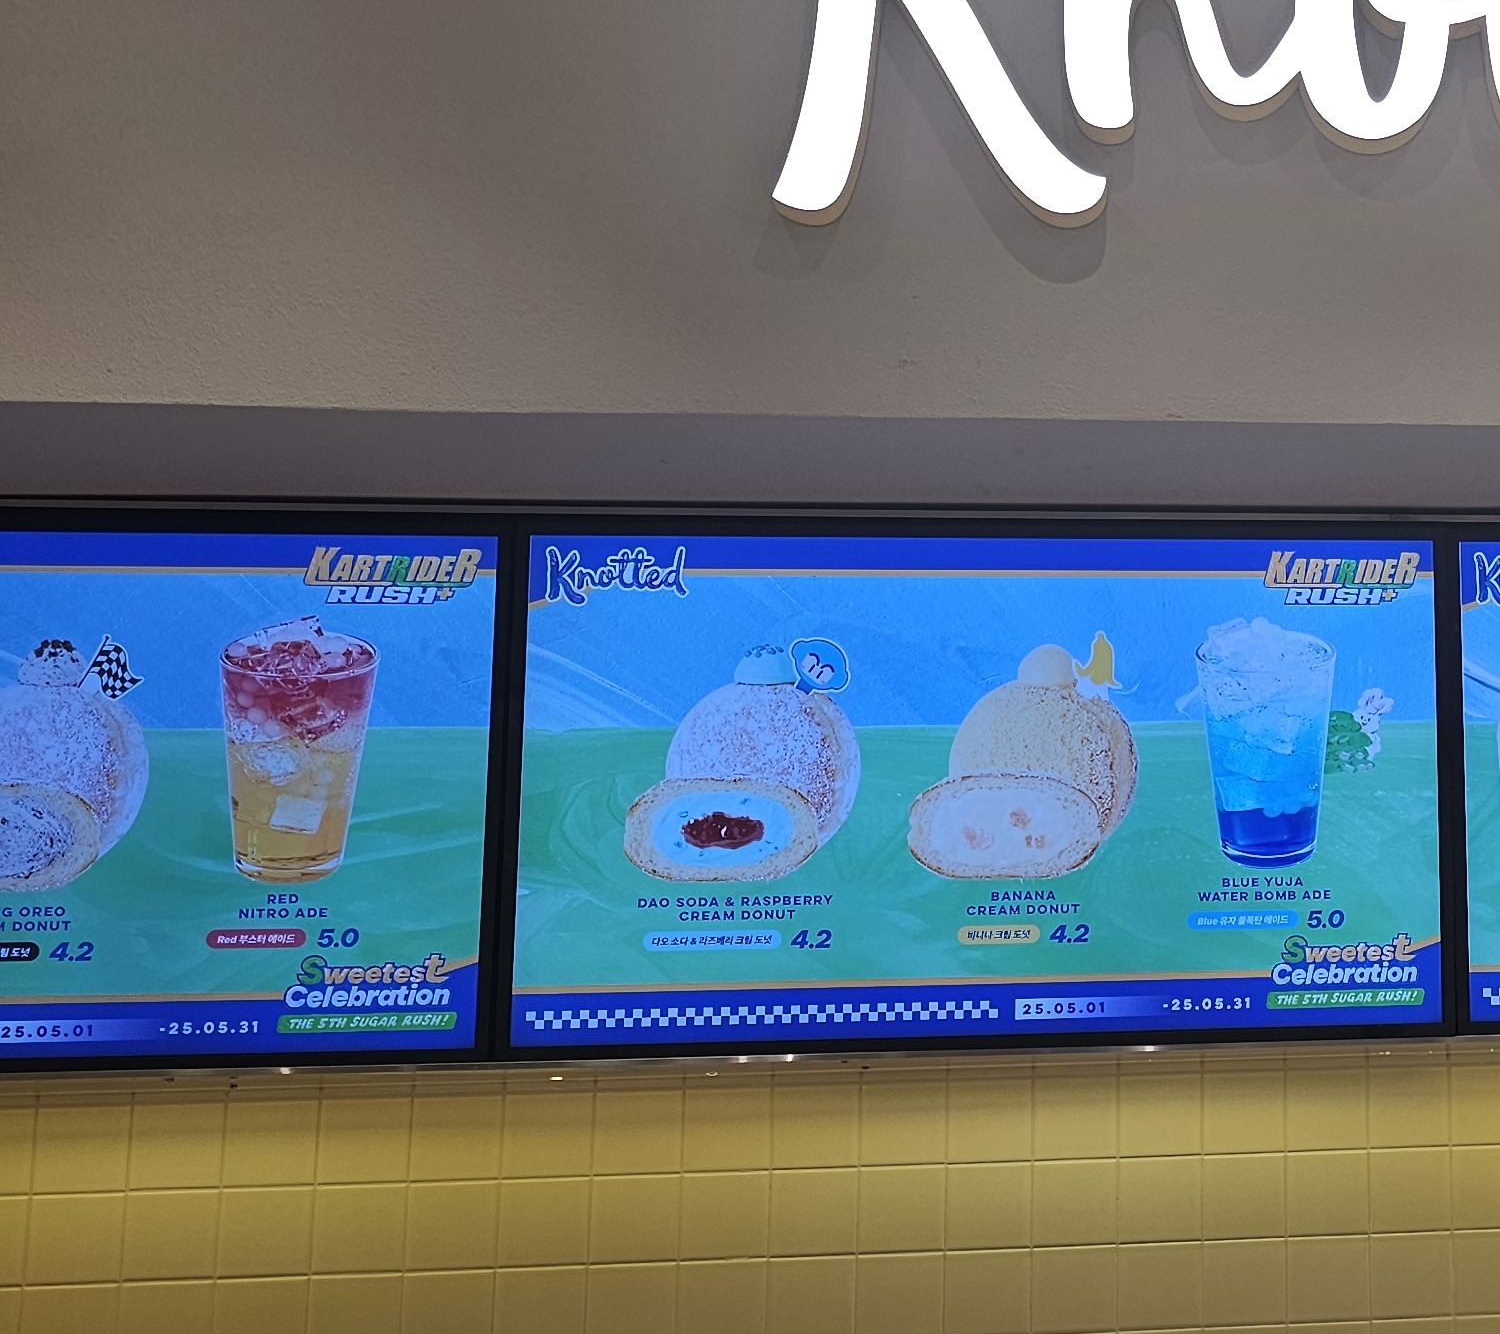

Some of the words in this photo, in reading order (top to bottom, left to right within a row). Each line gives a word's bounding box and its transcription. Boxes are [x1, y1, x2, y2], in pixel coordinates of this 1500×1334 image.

[304, 546, 482, 587] KARTRIDER
[1264, 551, 1420, 588] KARTRIDER
[545, 545, 690, 605] Knotted
[1222, 877, 1259, 888] BLUE
[1264, 877, 1303, 887] YUJA
[267, 894, 299, 904] RED
[637, 898, 670, 909] DAO
[676, 897, 719, 908] SODA
[725, 897, 734, 907] &
[741, 895, 833, 907] RASPBERRY
[991, 891, 1056, 901] BANANA
[1198, 891, 1248, 902] WATER
[1254, 890, 1297, 901] BOMB
[1302, 890, 1331, 900] ADE
[20, 906, 65, 917] OREO
[239, 908, 290, 919] NITRO
[295, 908, 328, 918] ADE
[679, 911, 734, 921] CREAM
[742, 910, 795, 920] DONUT
[966, 905, 1020, 916] CREAM
[1027, 904, 1080, 915] DONUT
[13, 921, 71, 931] DONUT
[1198, 917, 1218, 926] Blue
[1220, 916, 1236, 926] 유자
[1264, 914, 1288, 924] 에이드
[1307, 909, 1345, 929] 5.0
[217, 935, 237, 944] Red
[239, 934, 266, 944] 부스터
[268, 934, 295, 944] 에이드
[317, 928, 359, 948] 5.0
[652, 937, 669, 946] 다오
[670, 937, 689, 946] 소다
[699, 936, 733, 945] 라즈베리
[754, 935, 772, 945] 도넛
[790, 930, 832, 949] 4.2
[1050, 924, 1090, 943] 4.2
[49, 941, 94, 962] 4.2
[1281, 933, 1416, 964] Sweetest
[297, 953, 449, 985] Sweetest
[1271, 961, 1417, 985] Celebration
[284, 984, 450, 1008] Celebration
[1277, 995, 1299, 1005] THE
[1302, 994, 1328, 1005] 5TH
[1331, 993, 1372, 1003] SUGAR
[1376, 991, 1417, 1001] RUSH!
[1023, 1002, 1105, 1015] 25.05.01
[289, 1019, 312, 1029] THE
[317, 1018, 346, 1028] 5TH
[351, 1016, 397, 1028] SUGAR
[402, 1015, 449, 1026] RUSH!
[1, 1025, 93, 1039] 25.05.01
